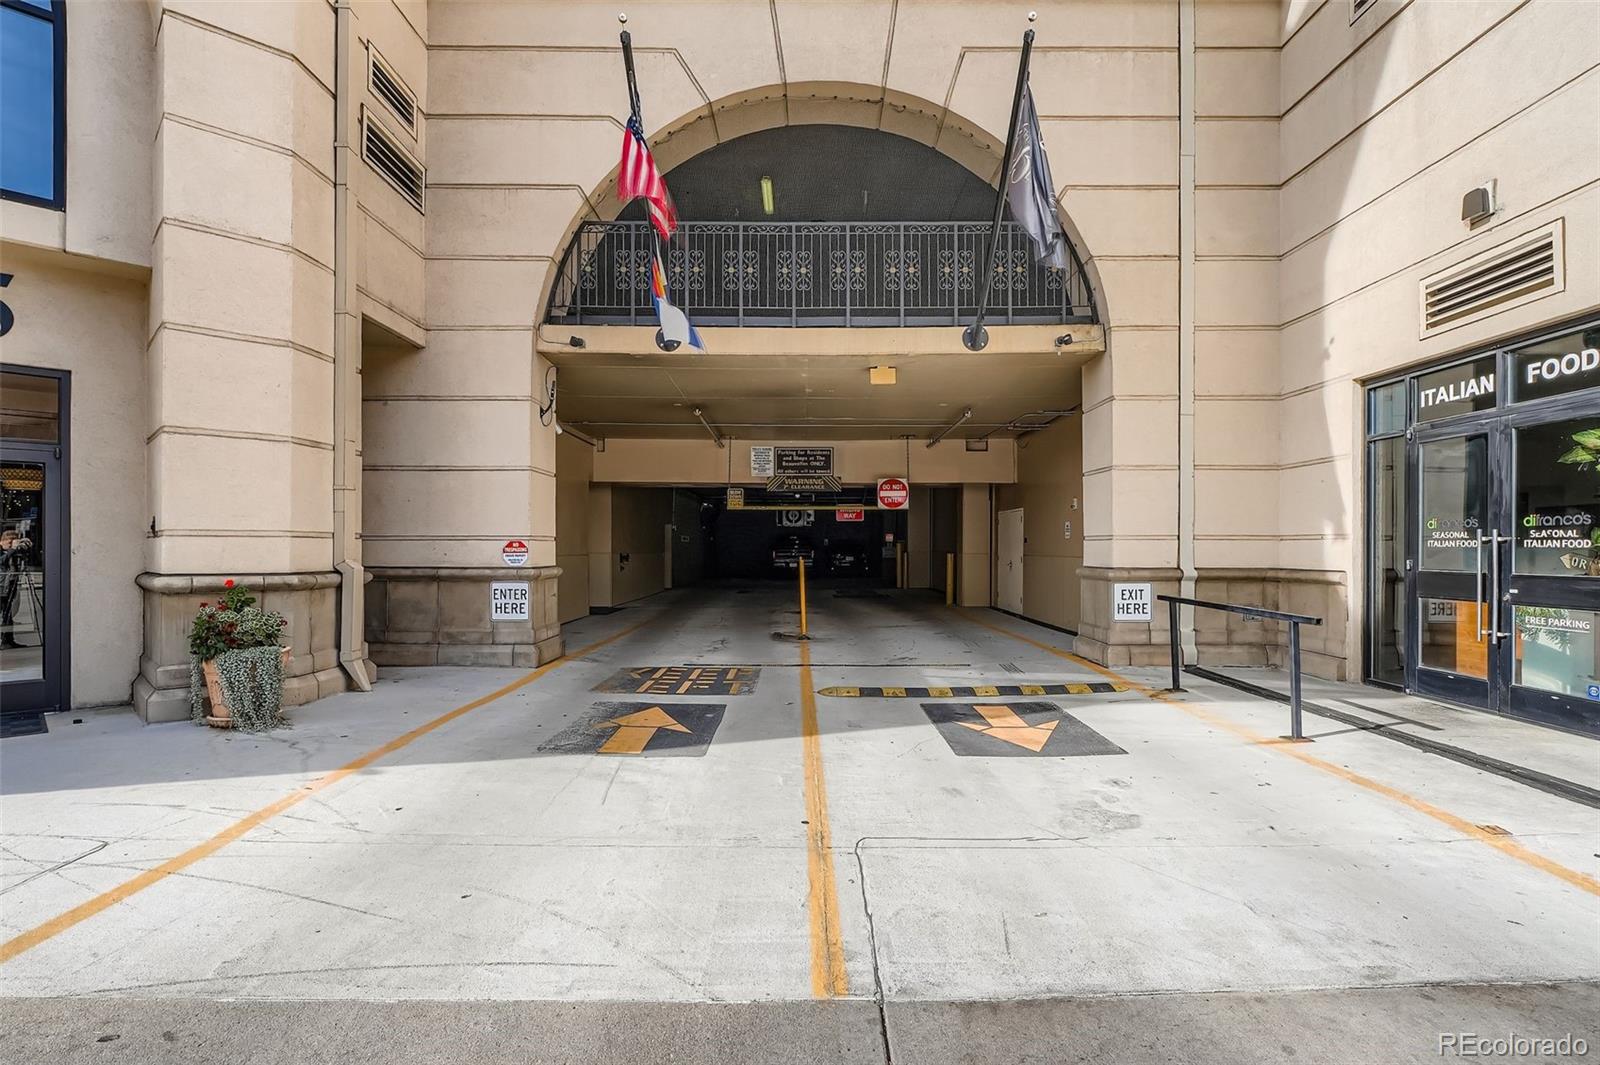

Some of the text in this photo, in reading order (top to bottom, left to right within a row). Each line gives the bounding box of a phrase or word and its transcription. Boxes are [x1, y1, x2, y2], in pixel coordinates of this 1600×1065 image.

[1420, 348, 1600, 408] ITALIAN FOOD
[1523, 512, 1592, 527] difranco's
[1432, 531, 1470, 539] SEASONAL
[1530, 529, 1580, 538] SEASONAL
[1523, 539, 1592, 548] ITALIAN FOOD
[493, 588, 527, 600] ENTER
[1121, 589, 1144, 600] EXIT
[495, 602, 526, 614] HERE
[1117, 603, 1149, 614] HERE
[1525, 616, 1590, 630] FREE PARKING
